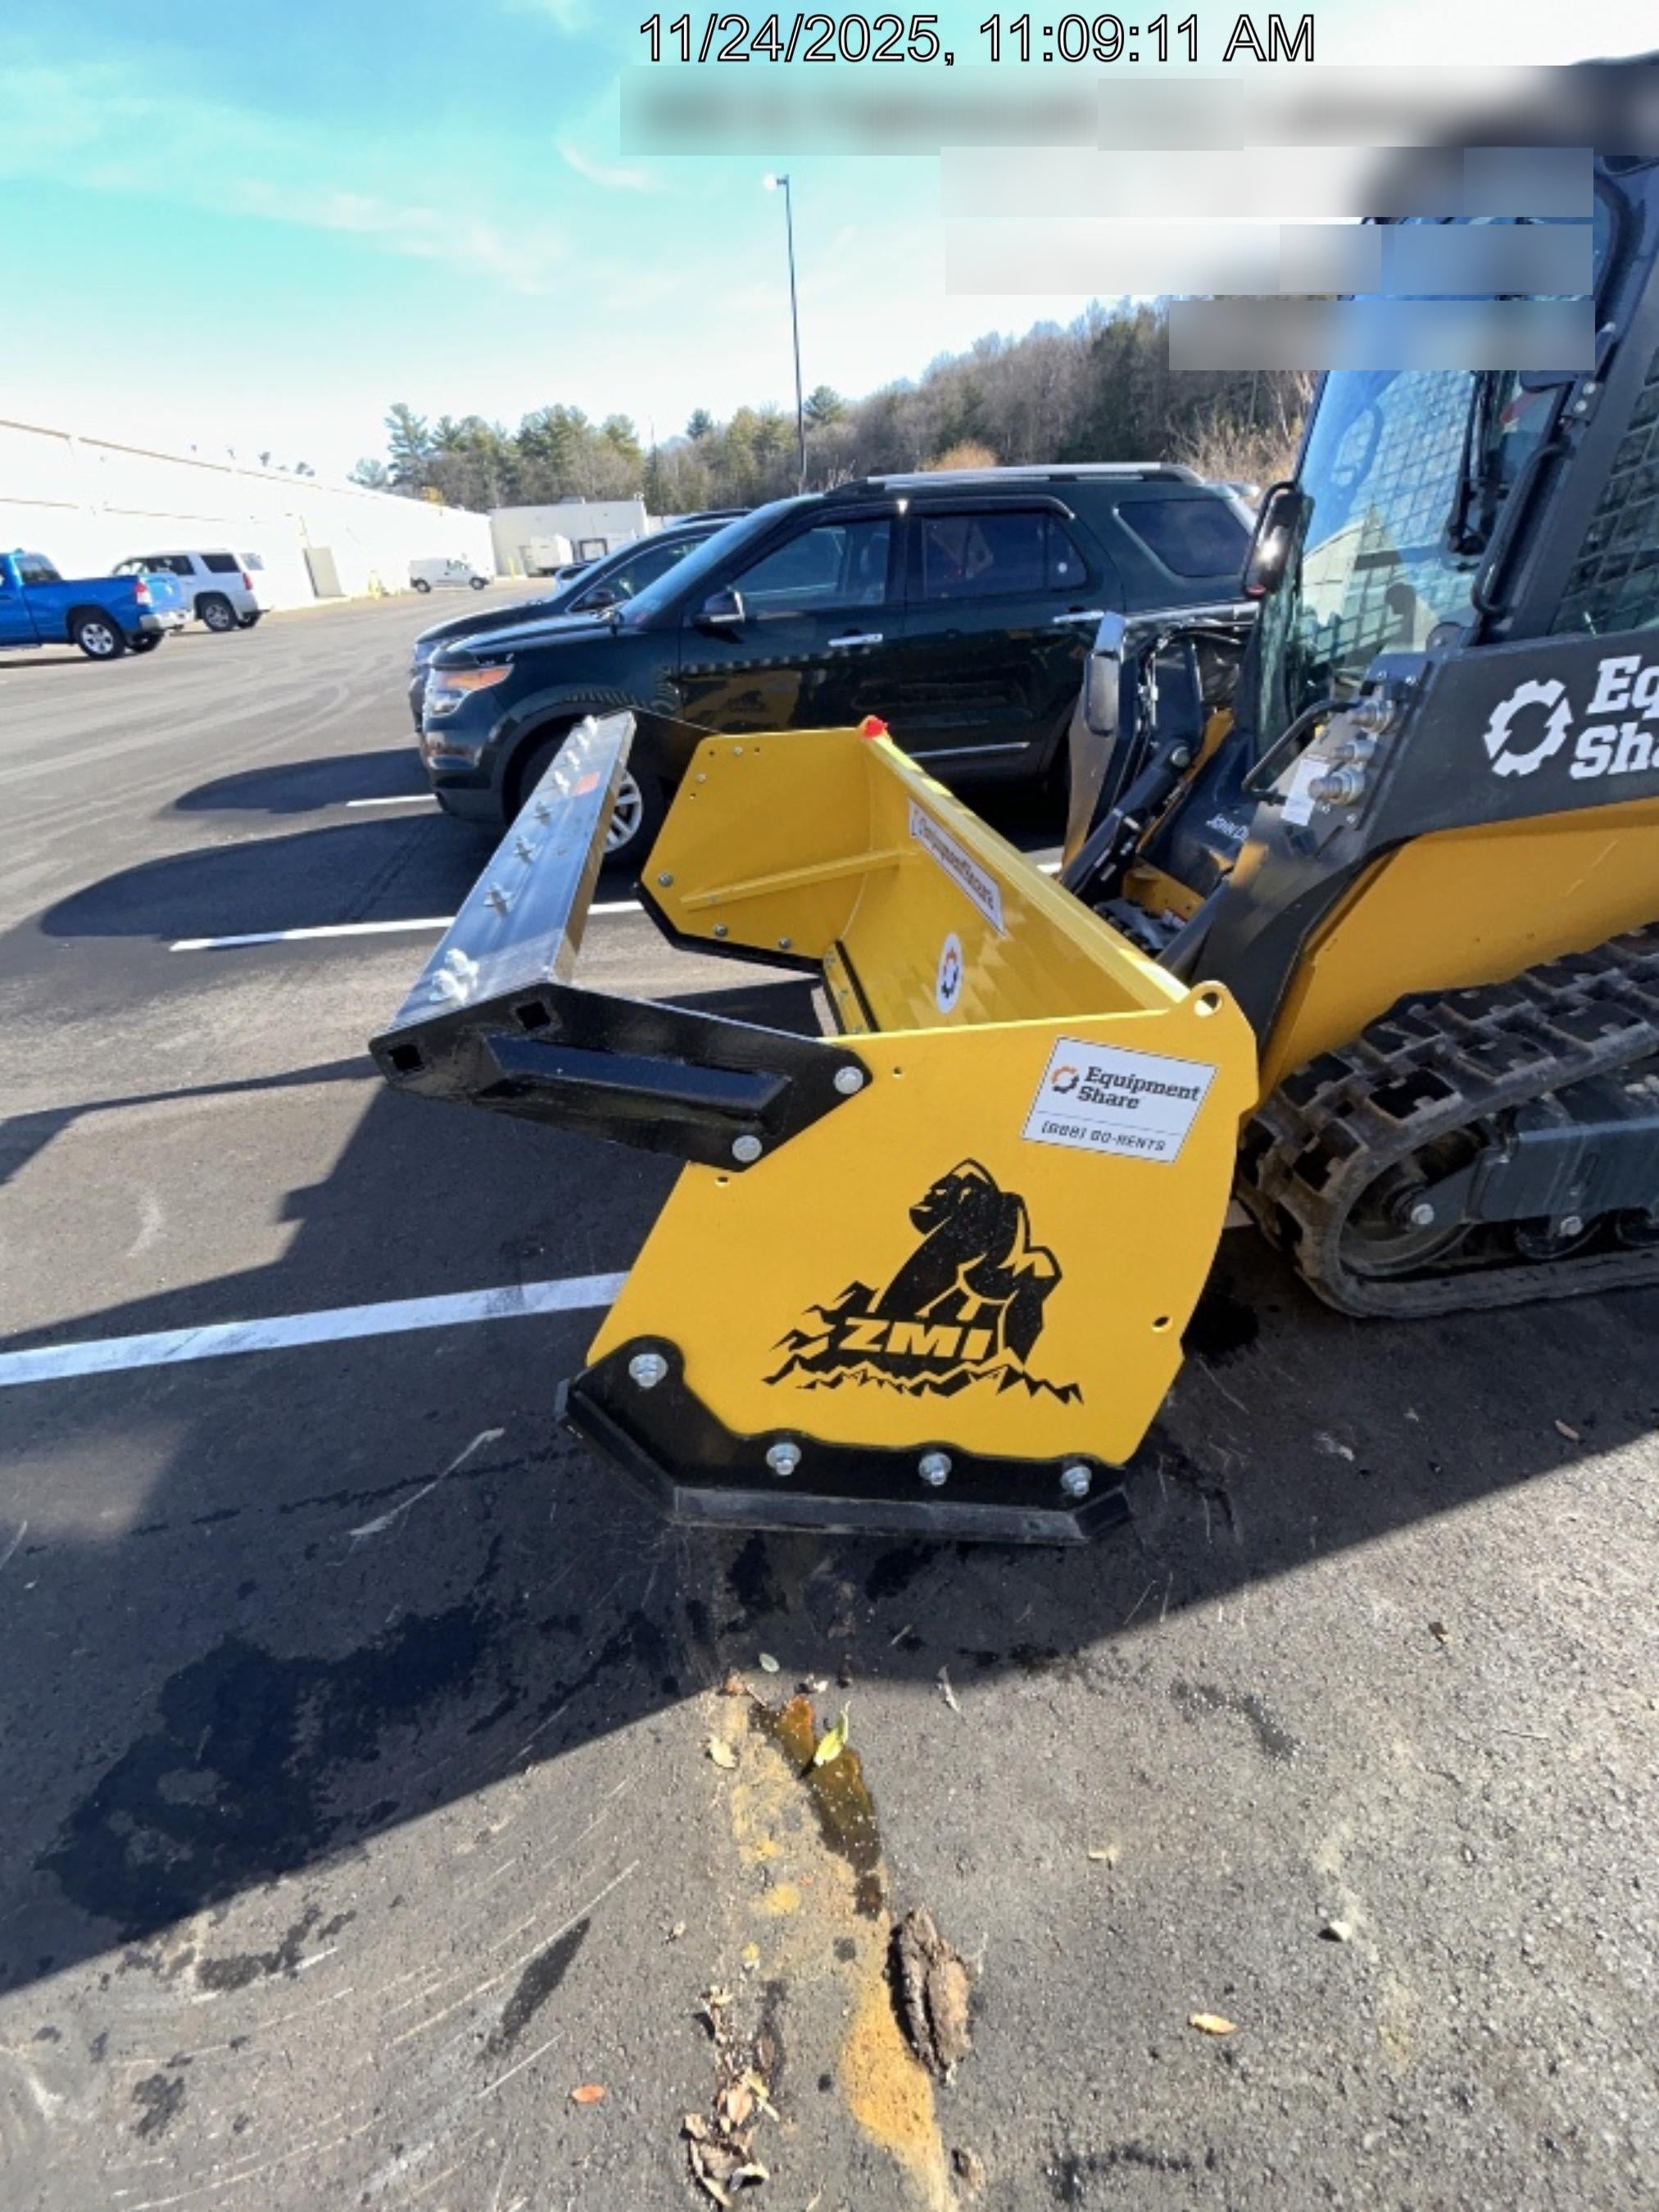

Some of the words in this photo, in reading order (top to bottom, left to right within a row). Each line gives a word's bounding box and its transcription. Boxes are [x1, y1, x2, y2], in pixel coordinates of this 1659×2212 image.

[1569, 721, 1659, 779] Sh
[1077, 1086, 1140, 1109] Share
[1084, 1066, 1200, 1101] Equipment
[839, 1317, 994, 1360] ZMI
